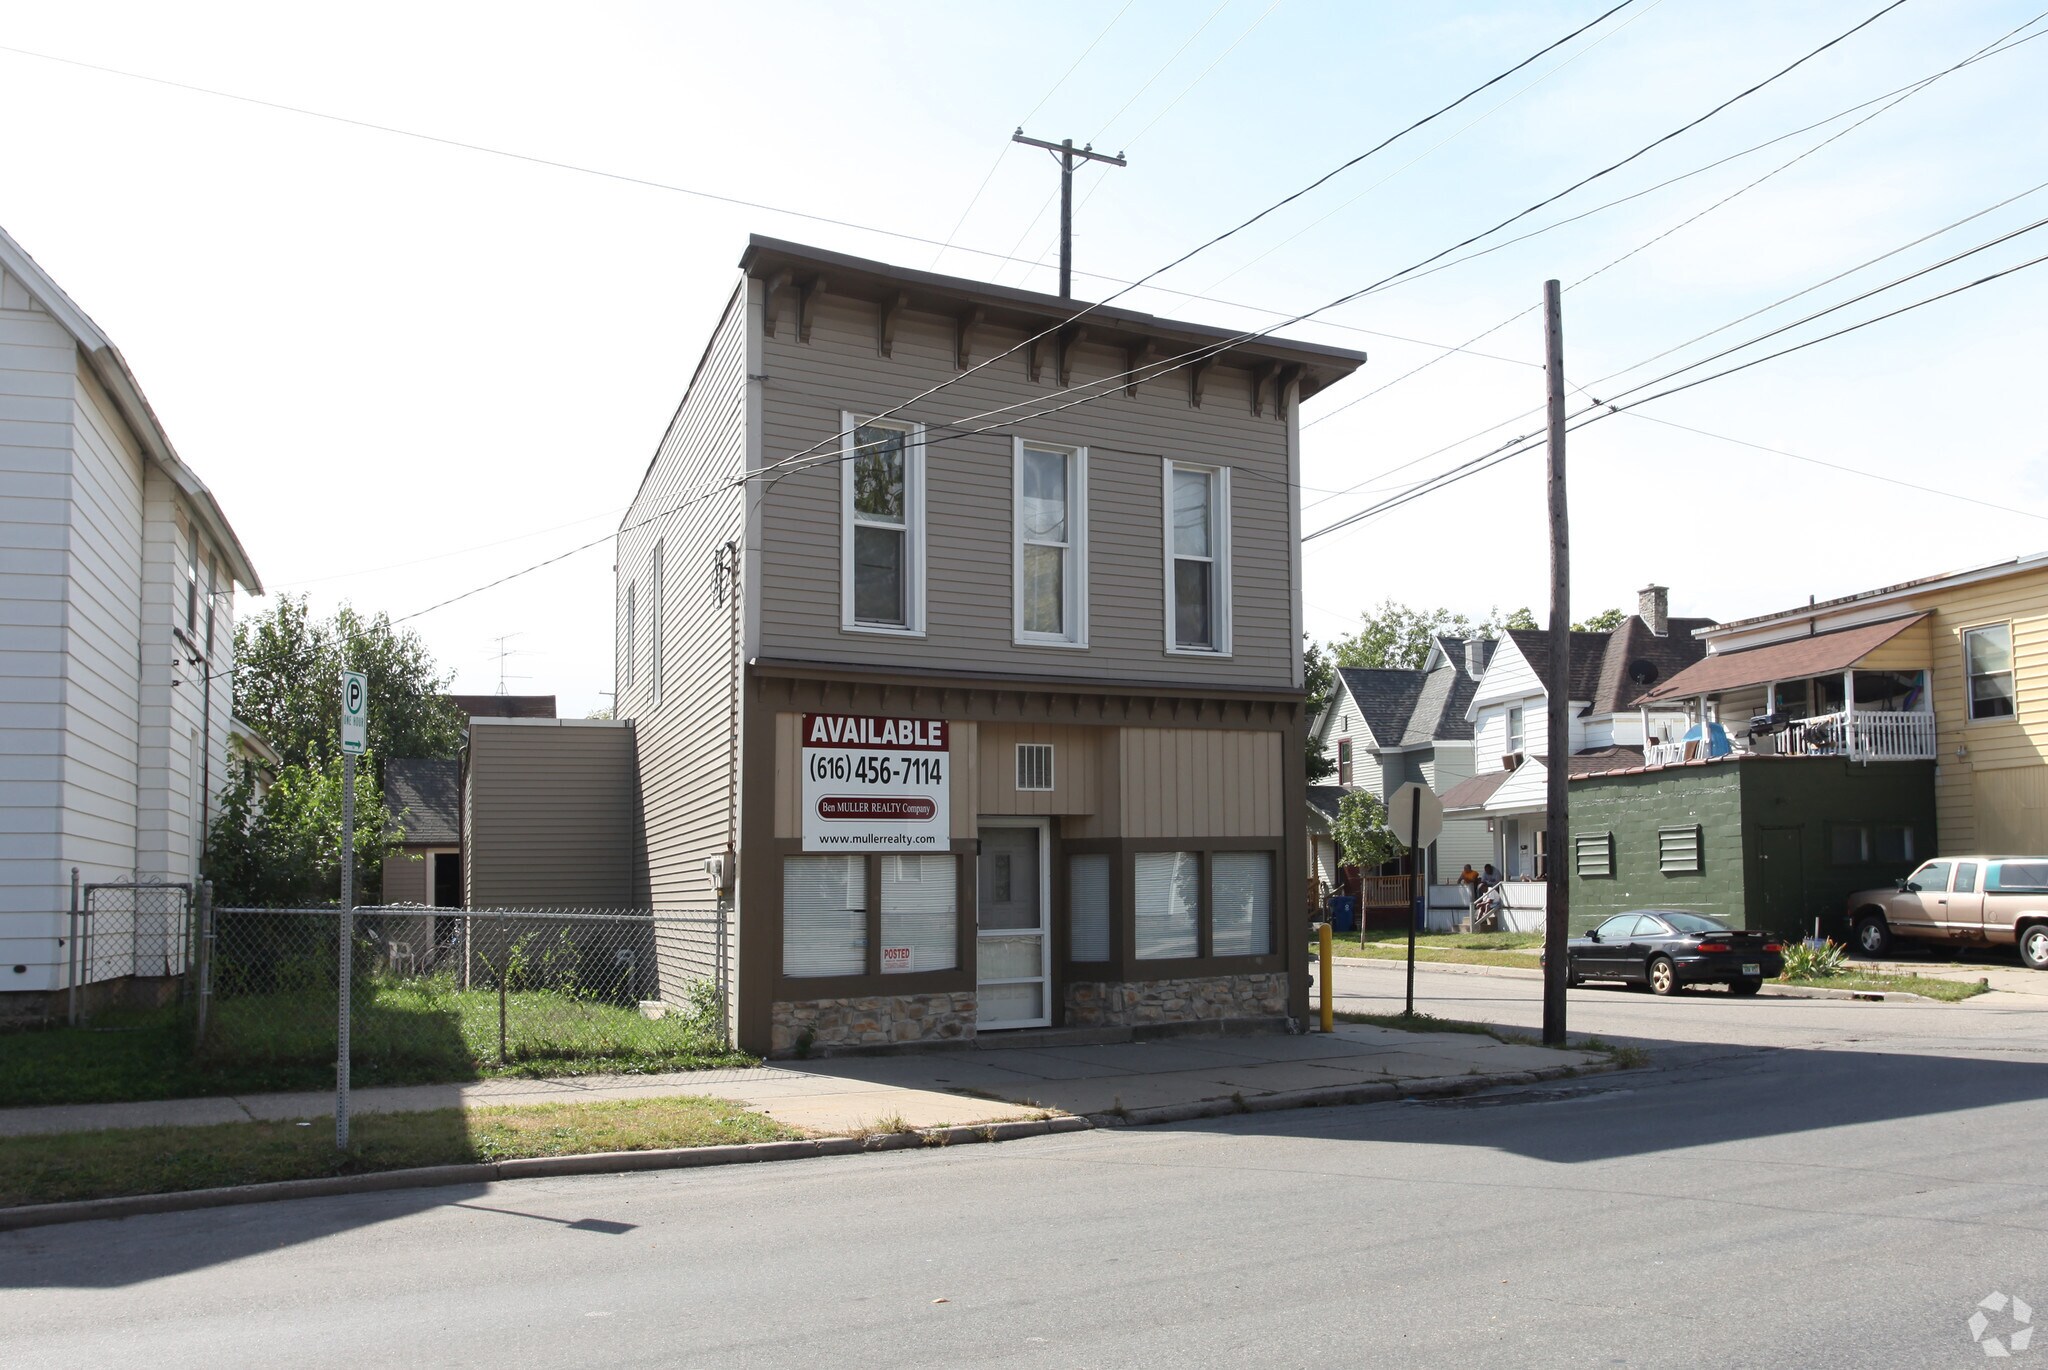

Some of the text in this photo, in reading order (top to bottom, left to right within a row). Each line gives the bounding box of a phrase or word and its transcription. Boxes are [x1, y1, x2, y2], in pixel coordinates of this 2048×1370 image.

[350, 684, 360, 707] P
[810, 716, 942, 746] AVAILABLE
[810, 753, 942, 785] (616) 456-7114
[822, 802, 931, 816] Ben MULLER REALTY Company
[819, 834, 936, 846] www.mullerrealty.com
[884, 948, 910, 960] POSTED
